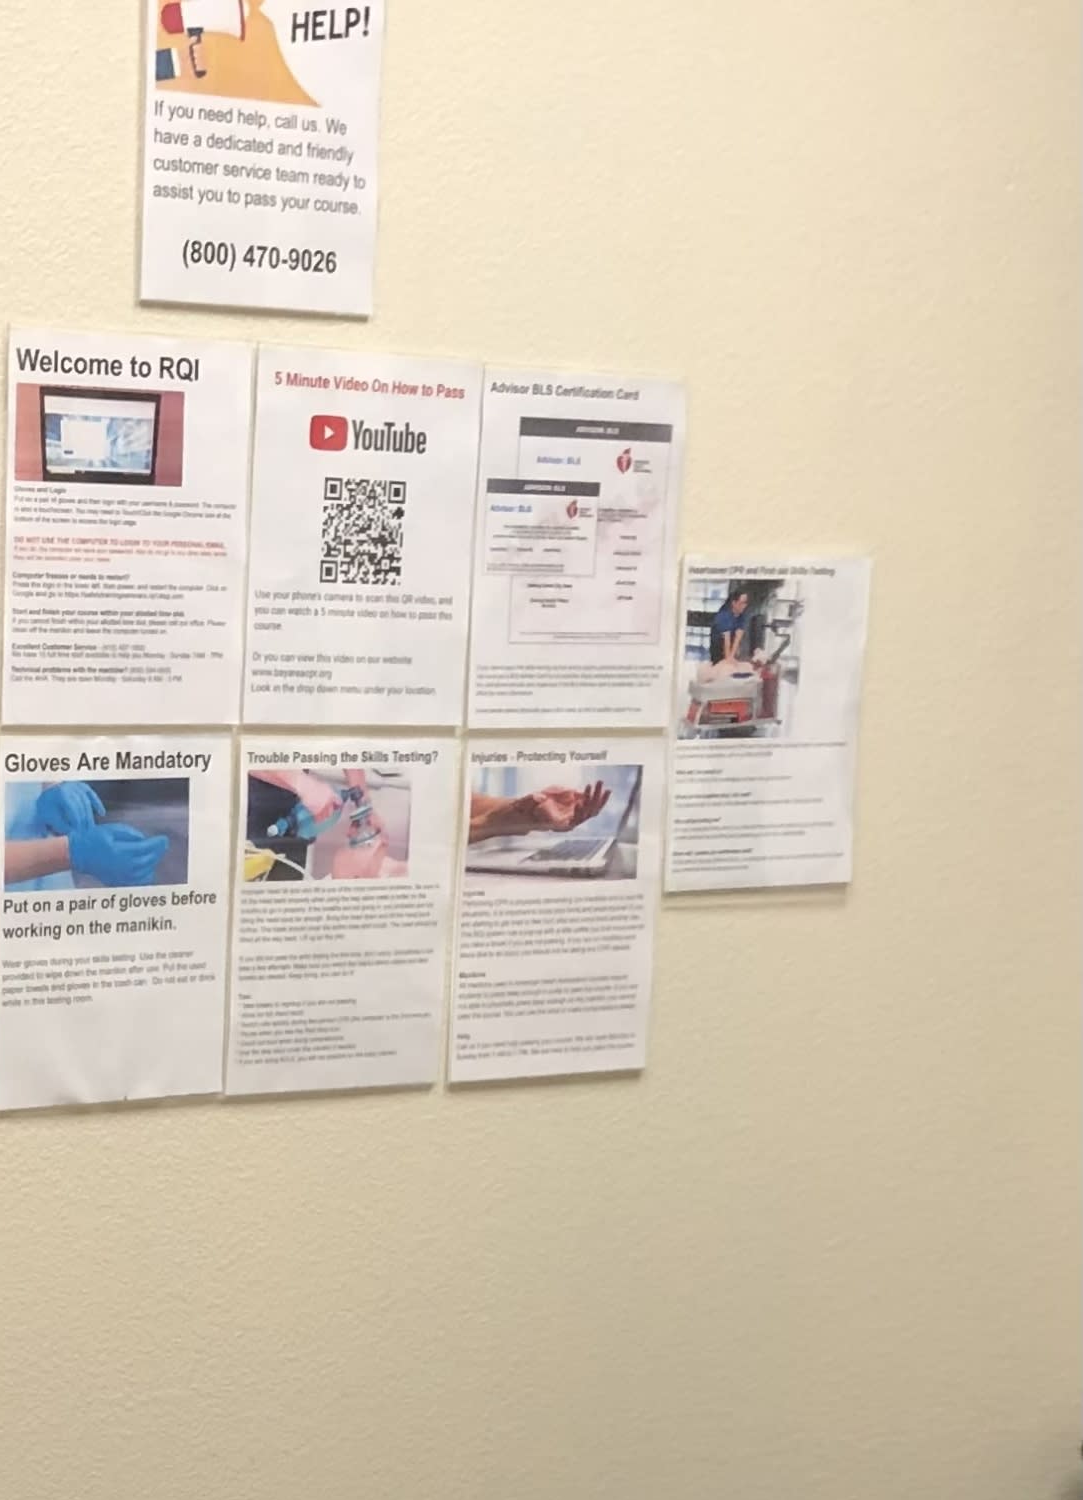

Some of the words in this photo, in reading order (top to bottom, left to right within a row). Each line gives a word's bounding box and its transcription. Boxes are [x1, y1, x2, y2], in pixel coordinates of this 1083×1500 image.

[291, 6, 370, 43] HELP!
[154, 100, 165, 117] If
[168, 105, 194, 122] you
[198, 107, 233, 124] need
[274, 114, 298, 129] call
[325, 118, 347, 136] We
[154, 128, 189, 146] have
[193, 134, 202, 148] a
[206, 133, 274, 154] dedicated
[277, 142, 303, 157] and
[306, 142, 354, 166] friendly
[153, 158, 220, 176] customer
[222, 164, 272, 181] service
[275, 166, 310, 184] team
[313, 172, 350, 191] ready
[353, 175, 366, 190] to
[153, 184, 194, 200] assist
[197, 189, 224, 205] you
[226, 189, 241, 205] to
[244, 192, 277, 209] pass
[281, 196, 311, 212] your
[182, 239, 236, 272] (800)
[242, 245, 337, 274] 470-9026
[16, 348, 123, 377] Welcome
[130, 356, 152, 378] to
[159, 356, 199, 382] RQI
[275, 371, 283, 386] 5
[286, 372, 331, 389] Minute
[333, 376, 369, 392] Video
[371, 378, 389, 393] On
[391, 381, 419, 395] How
[421, 384, 434, 397] to
[436, 383, 465, 399] Pass
[352, 419, 427, 454] YouTube
[5, 753, 70, 773] Gloves
[77, 752, 110, 771] Are
[116, 751, 211, 772] Mandatory
[247, 751, 290, 764] Trouble
[292, 751, 338, 765] Passing
[340, 751, 359, 763] the
[361, 750, 389, 763] Skills
[392, 750, 439, 765] Testing?
[3, 899, 28, 914] Put
[32, 901, 51, 913] on
[55, 900, 64, 912] a
[69, 896, 97, 915] pair
[101, 894, 117, 909] of
[119, 894, 167, 912] gloves
[171, 891, 217, 906] before
[2, 922, 62, 940] working
[66, 924, 84, 936] on
[89, 920, 112, 935] the
[116, 916, 176, 933] manikin.
